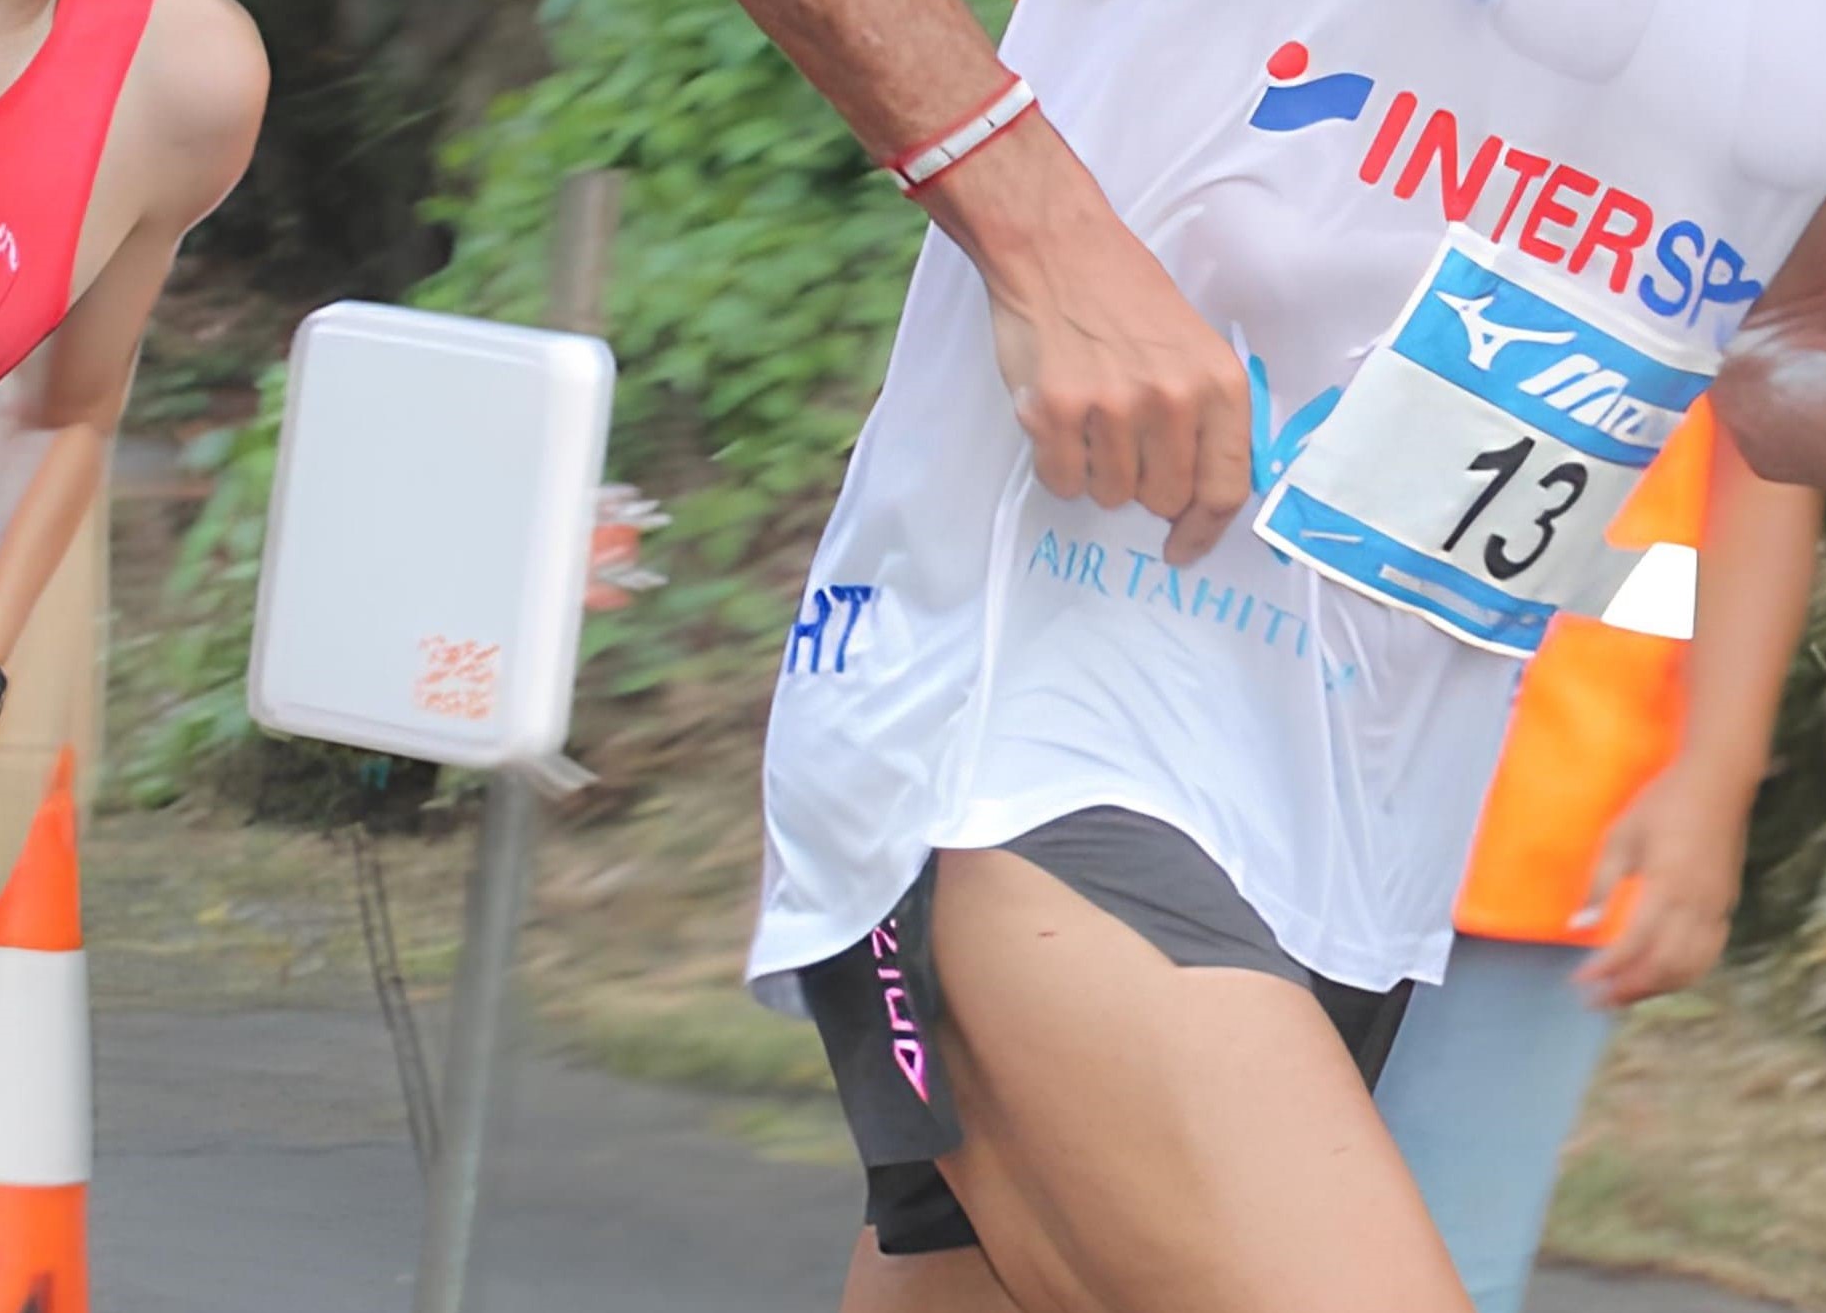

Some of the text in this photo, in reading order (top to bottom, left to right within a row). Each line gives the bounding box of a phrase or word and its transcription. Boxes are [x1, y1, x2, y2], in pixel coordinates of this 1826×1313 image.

[1359, 90, 1764, 329] INTERSP
[1441, 435, 1589, 581] 13
[1027, 526, 1111, 598] AIR
[1125, 546, 1310, 659] TAHITI
